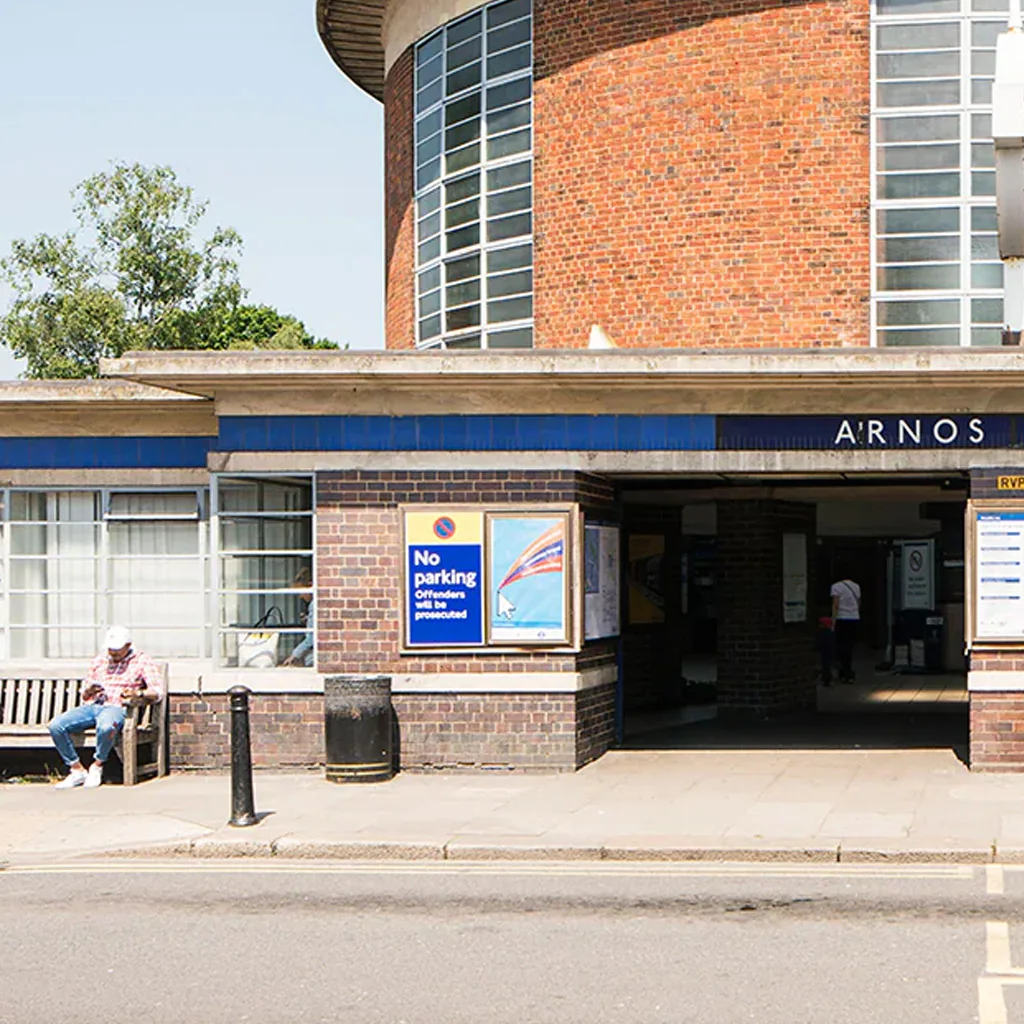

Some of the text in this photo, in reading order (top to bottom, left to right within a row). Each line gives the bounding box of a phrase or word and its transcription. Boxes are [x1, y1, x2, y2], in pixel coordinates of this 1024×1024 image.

[834, 418, 985, 445] ARNOS
[414, 549, 441, 566] No
[414, 569, 477, 589] parking
[414, 589, 466, 599] Offenders
[414, 600, 447, 610] will be
[414, 609, 468, 622] prosecuted
